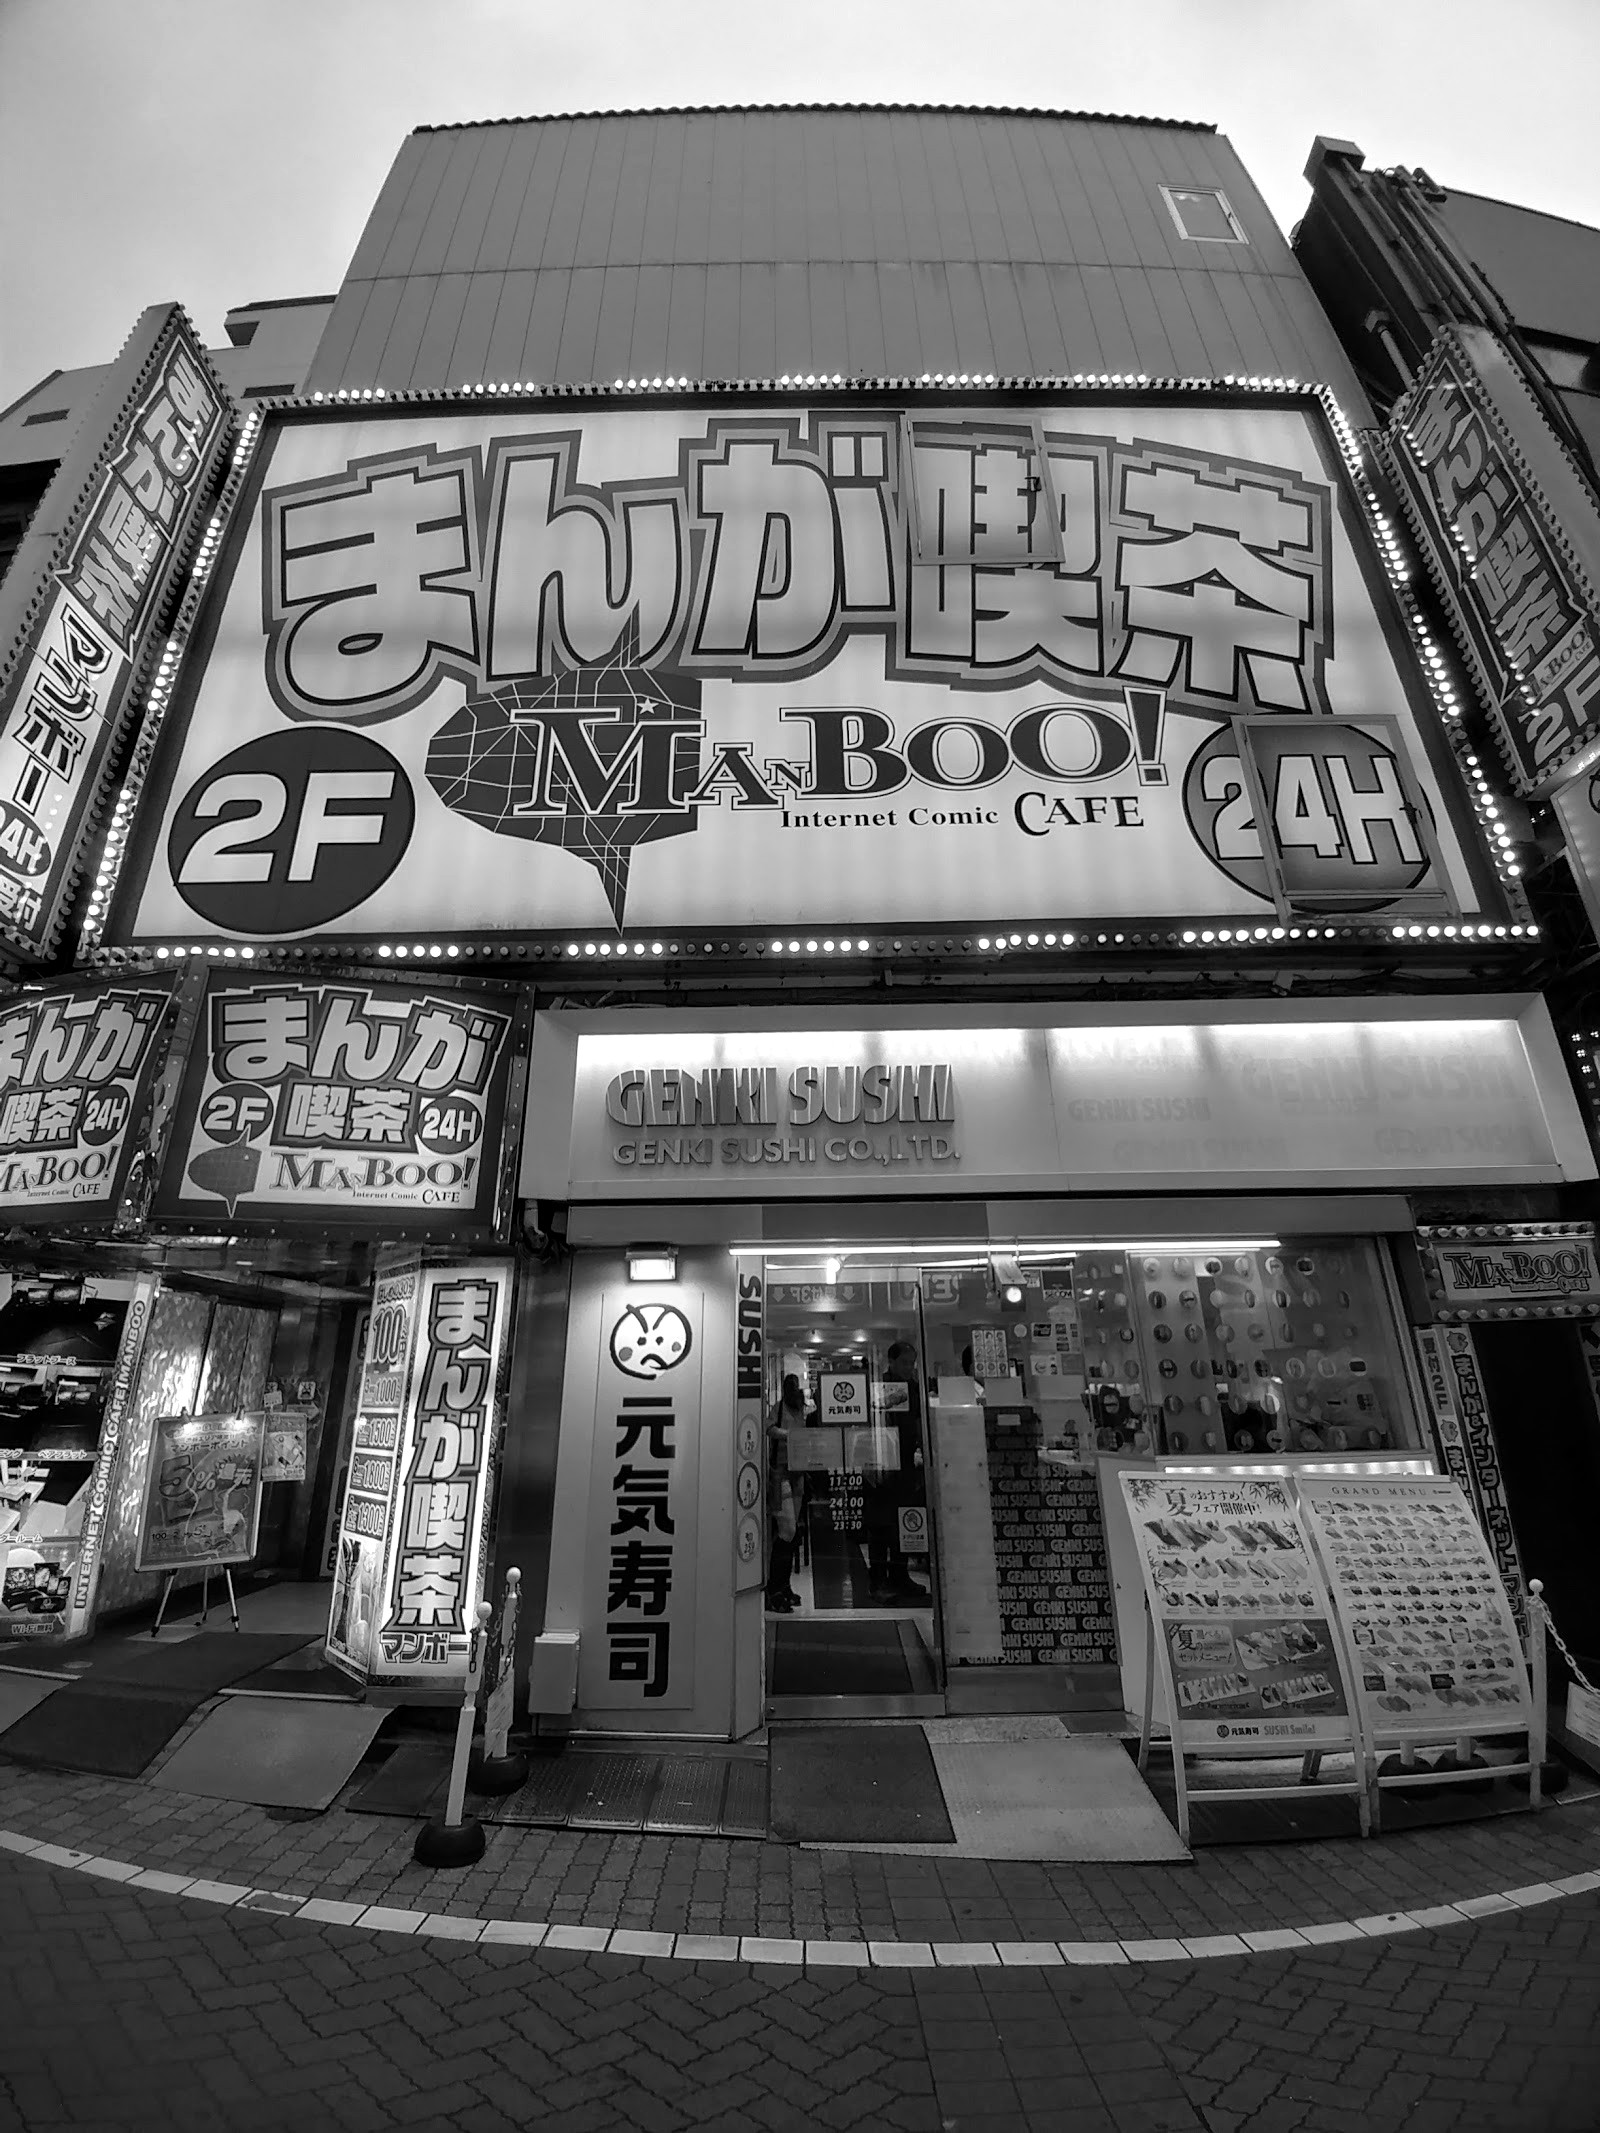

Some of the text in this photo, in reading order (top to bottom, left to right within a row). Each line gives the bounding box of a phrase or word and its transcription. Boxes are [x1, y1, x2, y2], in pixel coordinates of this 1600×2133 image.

[272, 424, 1322, 716] まんが喫茶
[1525, 655, 1600, 766] 2F
[781, 791, 1144, 837] Internet Comic CAFE
[1202, 754, 1427, 864] 24H
[178, 770, 395, 884] 2F
[0, 815, 46, 874] 4H
[223, 997, 497, 1091] まんが
[605, 1064, 955, 1127] GENKI SUSHI
[0, 1087, 83, 1145] 喫茶
[82, 1097, 129, 1132] 24H
[207, 1097, 269, 1131] 2F
[290, 1083, 411, 1143] 喫茶
[422, 1109, 477, 1143] 24H
[612, 1135, 961, 1166] GENKI SUSHI CO.,LTD.
[73, 1183, 101, 1198] CAFE
[422, 1190, 461, 1205] CAFE
[737, 1273, 762, 1399] SUSHI
[375, 1376, 398, 1405] 1000
[828, 1405, 862, 1415] 元気寿司
[74, 1301, 145, 1608] INTERNET COMIC CAFE MANBOO
[399, 1286, 490, 1626] まんが喫茶
[829, 1475, 863, 1487] 11:00
[1331, 1486, 1380, 1496] GRAND
[1388, 1487, 1427, 1497] MENU
[829, 1496, 864, 1508] 24:00
[1010, 1494, 1039, 1506] SUSHI
[1046, 1494, 1077, 1506] GENKI
[1160, 1486, 1194, 1517] 夏
[834, 1520, 862, 1531] 23:30
[1024, 1509, 1055, 1521] GENKI
[1057, 1509, 1087, 1521] SUSHI
[1003, 1524, 1034, 1537] GENKI
[1035, 1524, 1066, 1537] SUSHI
[606, 1396, 676, 1698] 元気寿司
[1014, 1539, 1044, 1552] SUSHI
[1051, 1539, 1082, 1552] GENKI
[1029, 1554, 1060, 1567] GENKI
[1062, 1554, 1093, 1567] SUSHI
[1007, 1569, 1038, 1583] GENKI
[1040, 1569, 1071, 1583] SUSHI
[1019, 1585, 1049, 1599] SUSHI
[1055, 1585, 1087, 1599] GENKI
[1034, 1601, 1065, 1615] GENKI
[1067, 1601, 1098, 1615] SUSHI
[1011, 1617, 1043, 1631] GENKI
[1045, 1617, 1076, 1631] SUSHI
[380, 1631, 470, 1664] マンボー
[1023, 1633, 1054, 1647] SUSHI
[1060, 1633, 1092, 1647] GENKI
[1178, 1629, 1196, 1651] 夏
[1038, 1649, 1070, 1663] GENKI
[1071, 1649, 1103, 1663] SUSHI
[1263, 1726, 1289, 1736] SUSHI
